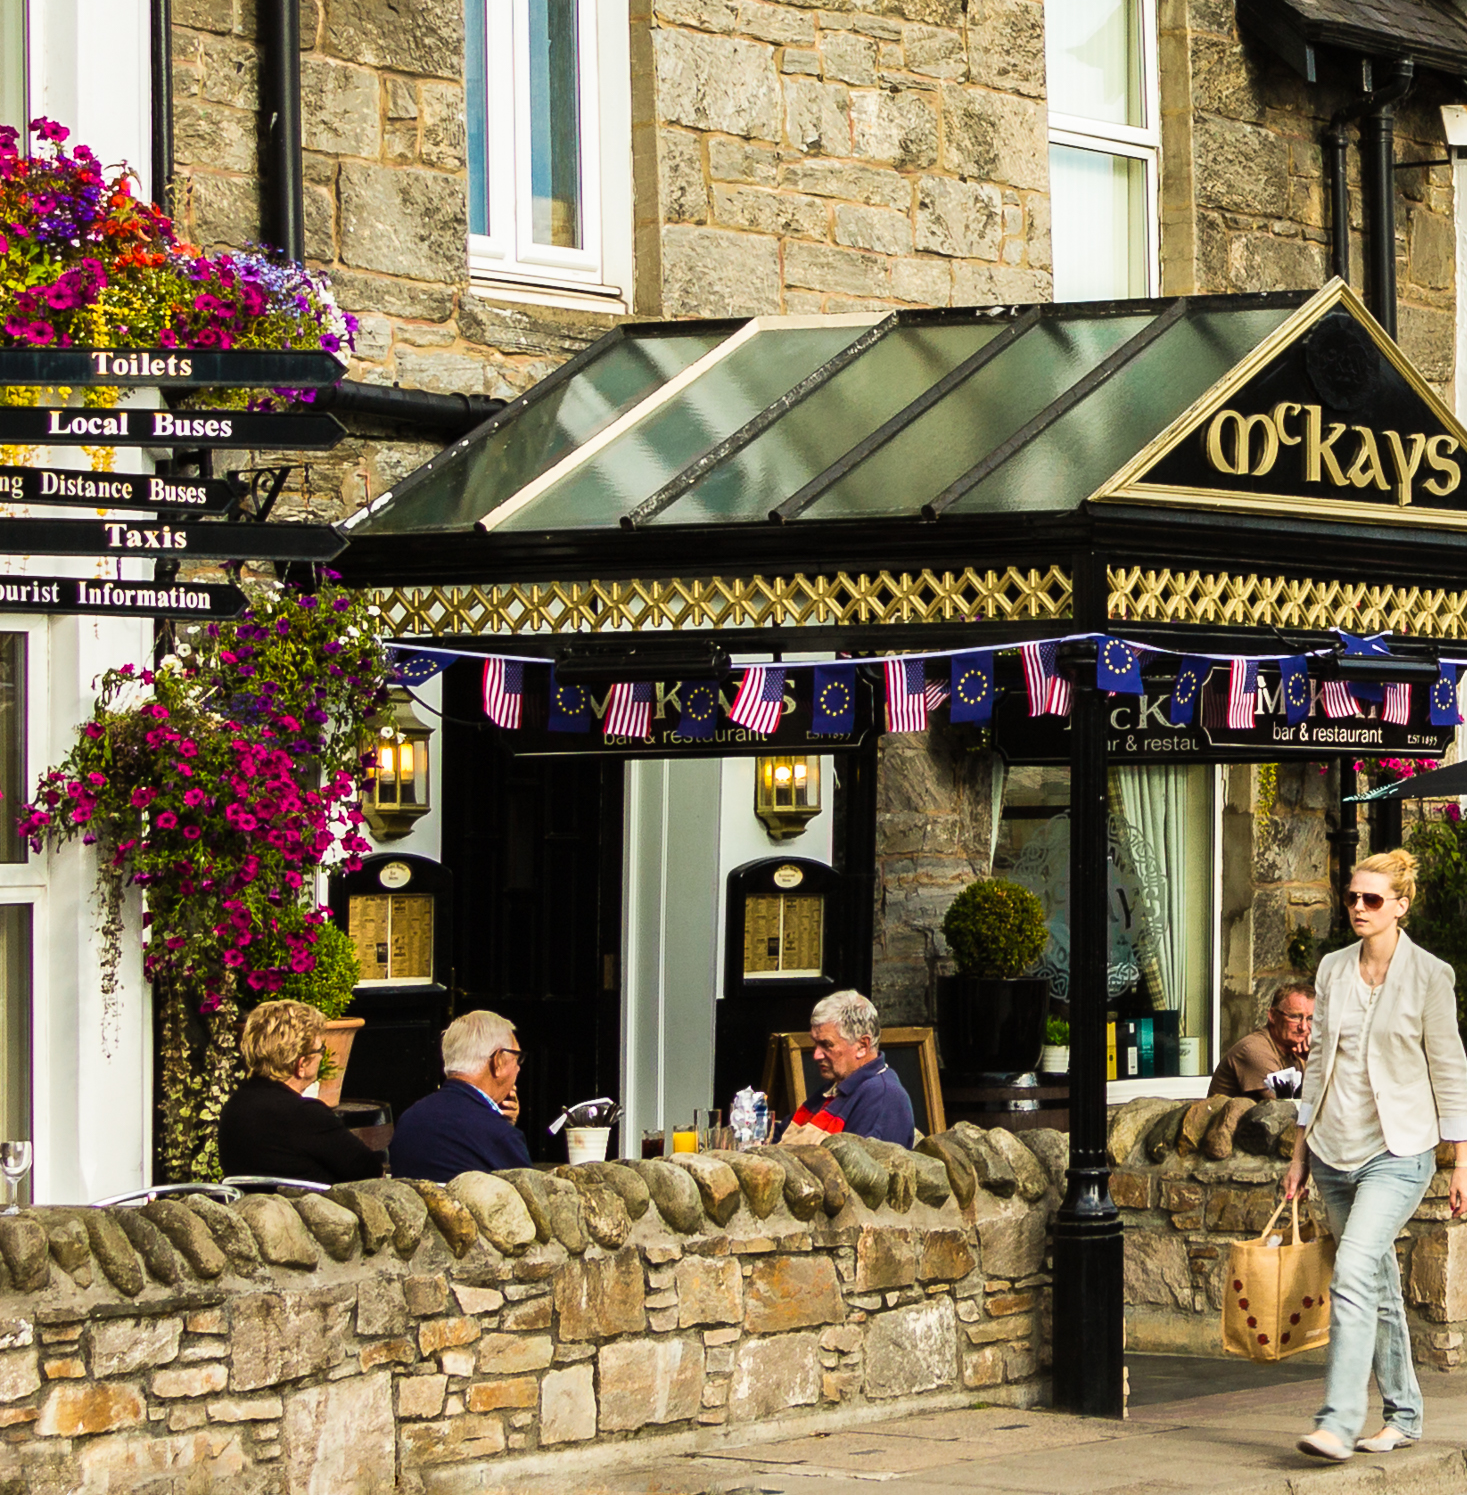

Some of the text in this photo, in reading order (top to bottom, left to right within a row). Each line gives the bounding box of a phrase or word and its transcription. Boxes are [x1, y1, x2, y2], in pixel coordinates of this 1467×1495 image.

[92, 352, 192, 376] Toilets
[49, 410, 232, 437] Local Buses
[0, 471, 206, 504] ng Distance Buses
[105, 523, 187, 548] Taxis
[0, 580, 211, 609] ourist Information
[1126, 735, 1137, 751] &
[1273, 721, 1382, 744] bar & restaurant
[1407, 734, 1420, 744] EST
